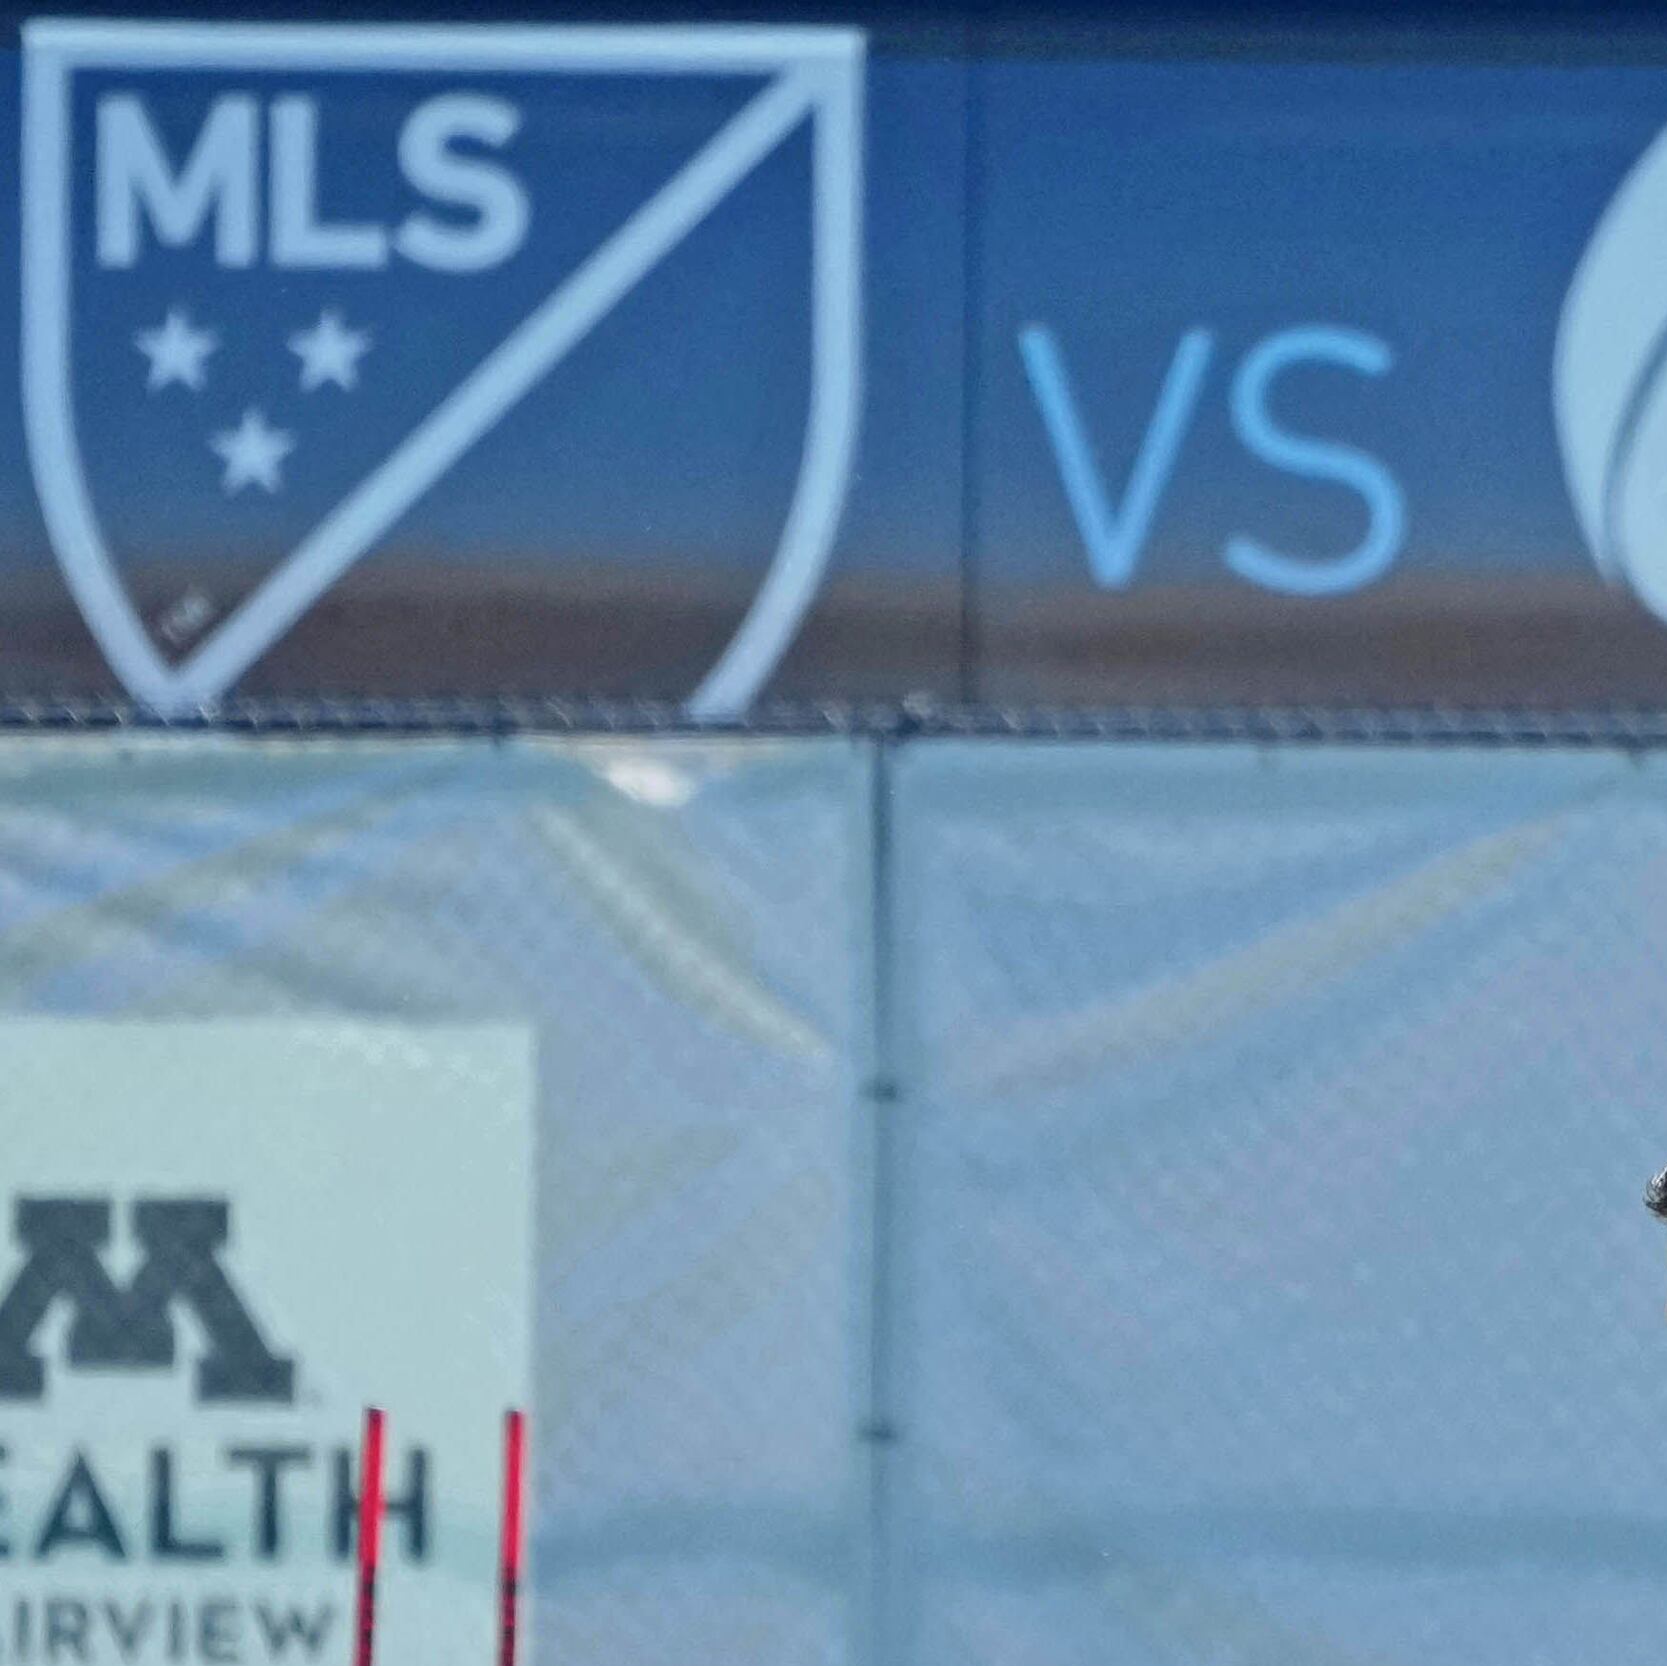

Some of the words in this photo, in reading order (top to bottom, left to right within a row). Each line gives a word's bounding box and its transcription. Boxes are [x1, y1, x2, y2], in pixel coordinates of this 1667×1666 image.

[95, 91, 532, 273] MLS
[1018, 323, 1407, 598] VS
[0, 1446, 431, 1561] ALTH
[0, 1598, 338, 1664] IRVIEW
